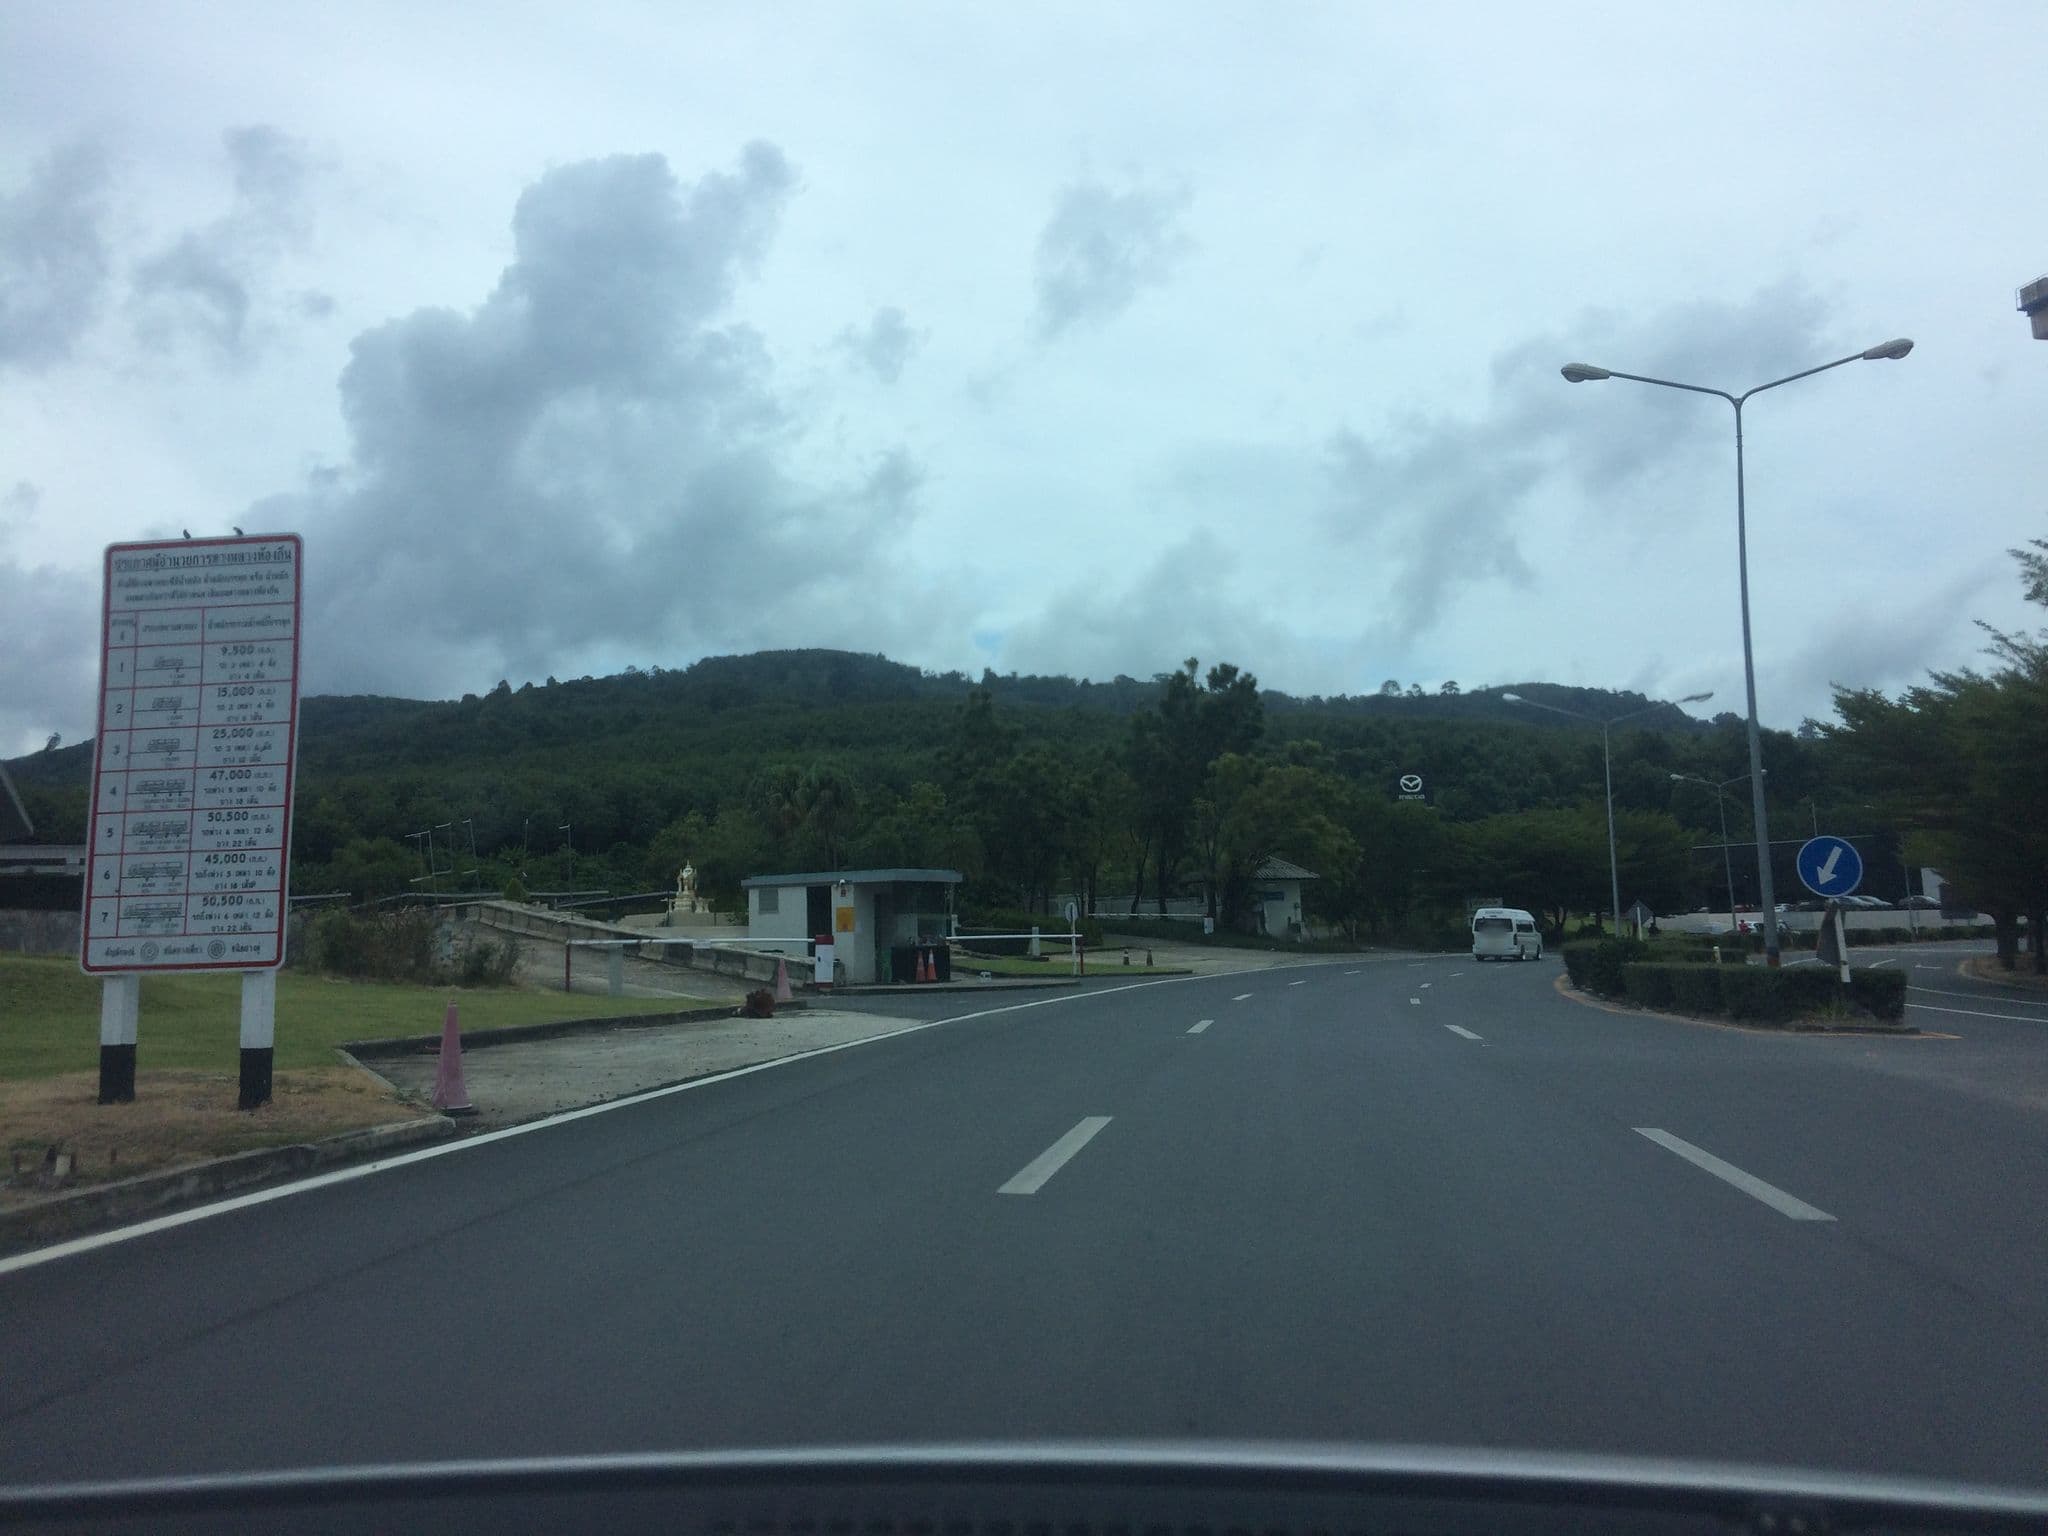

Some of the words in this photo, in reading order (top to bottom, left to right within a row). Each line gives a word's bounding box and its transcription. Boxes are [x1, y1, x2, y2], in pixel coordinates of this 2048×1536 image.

[116, 704, 123, 713] 2
[113, 745, 121, 755] 3
[109, 787, 117, 796] 4
[106, 828, 114, 838] 5
[104, 870, 111, 880] 6
[101, 912, 109, 922] 7
